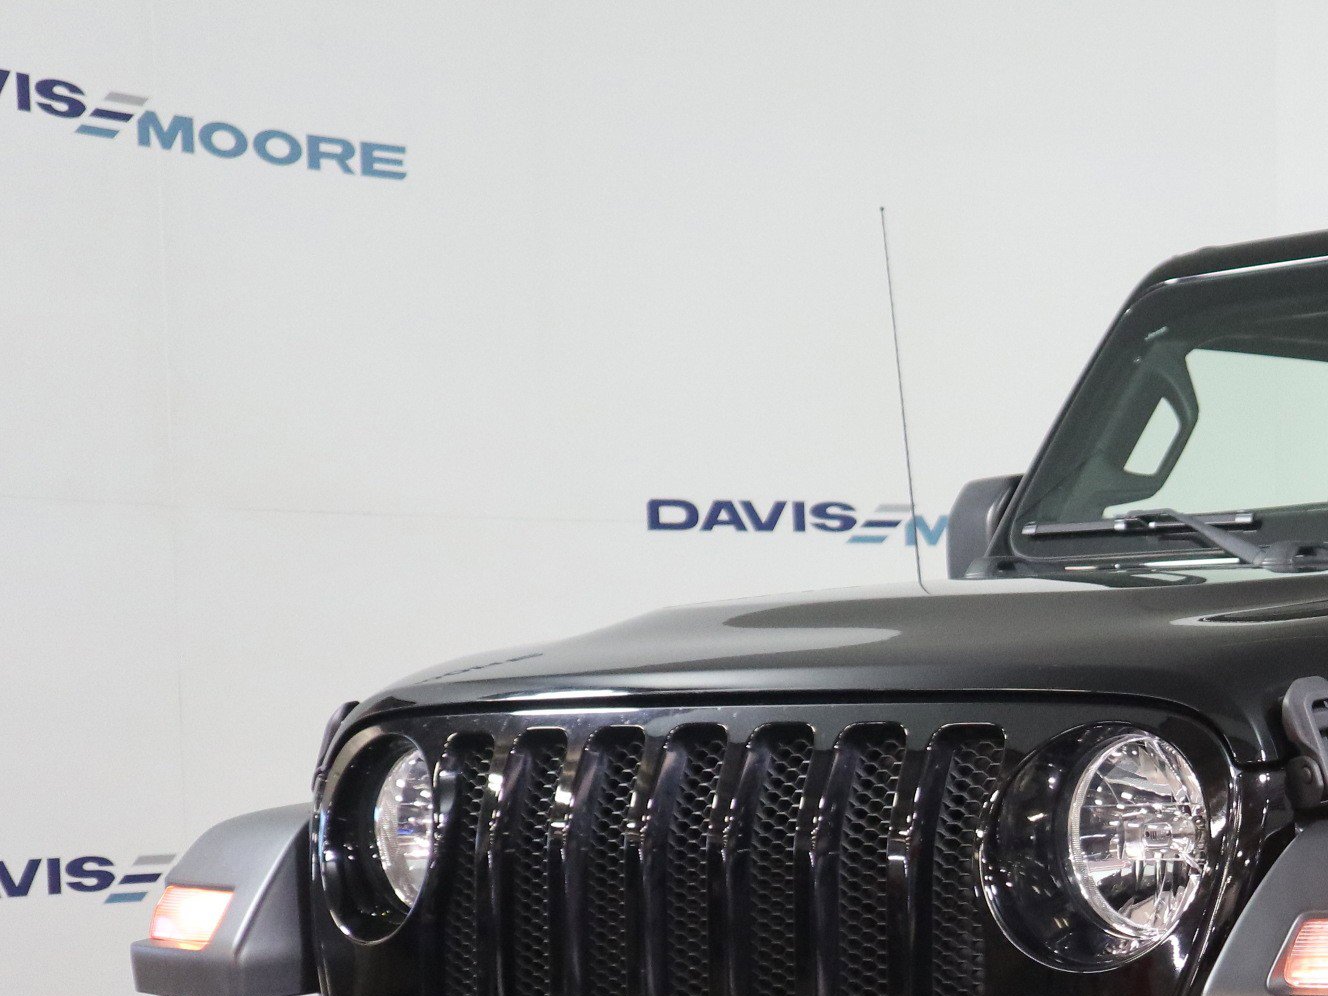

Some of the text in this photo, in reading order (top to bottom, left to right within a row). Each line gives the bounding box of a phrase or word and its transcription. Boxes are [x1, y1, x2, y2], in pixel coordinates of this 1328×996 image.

[0, 69, 407, 180] IS MOORE
[647, 498, 858, 533] DAVIS
[0, 855, 116, 899] VIS
